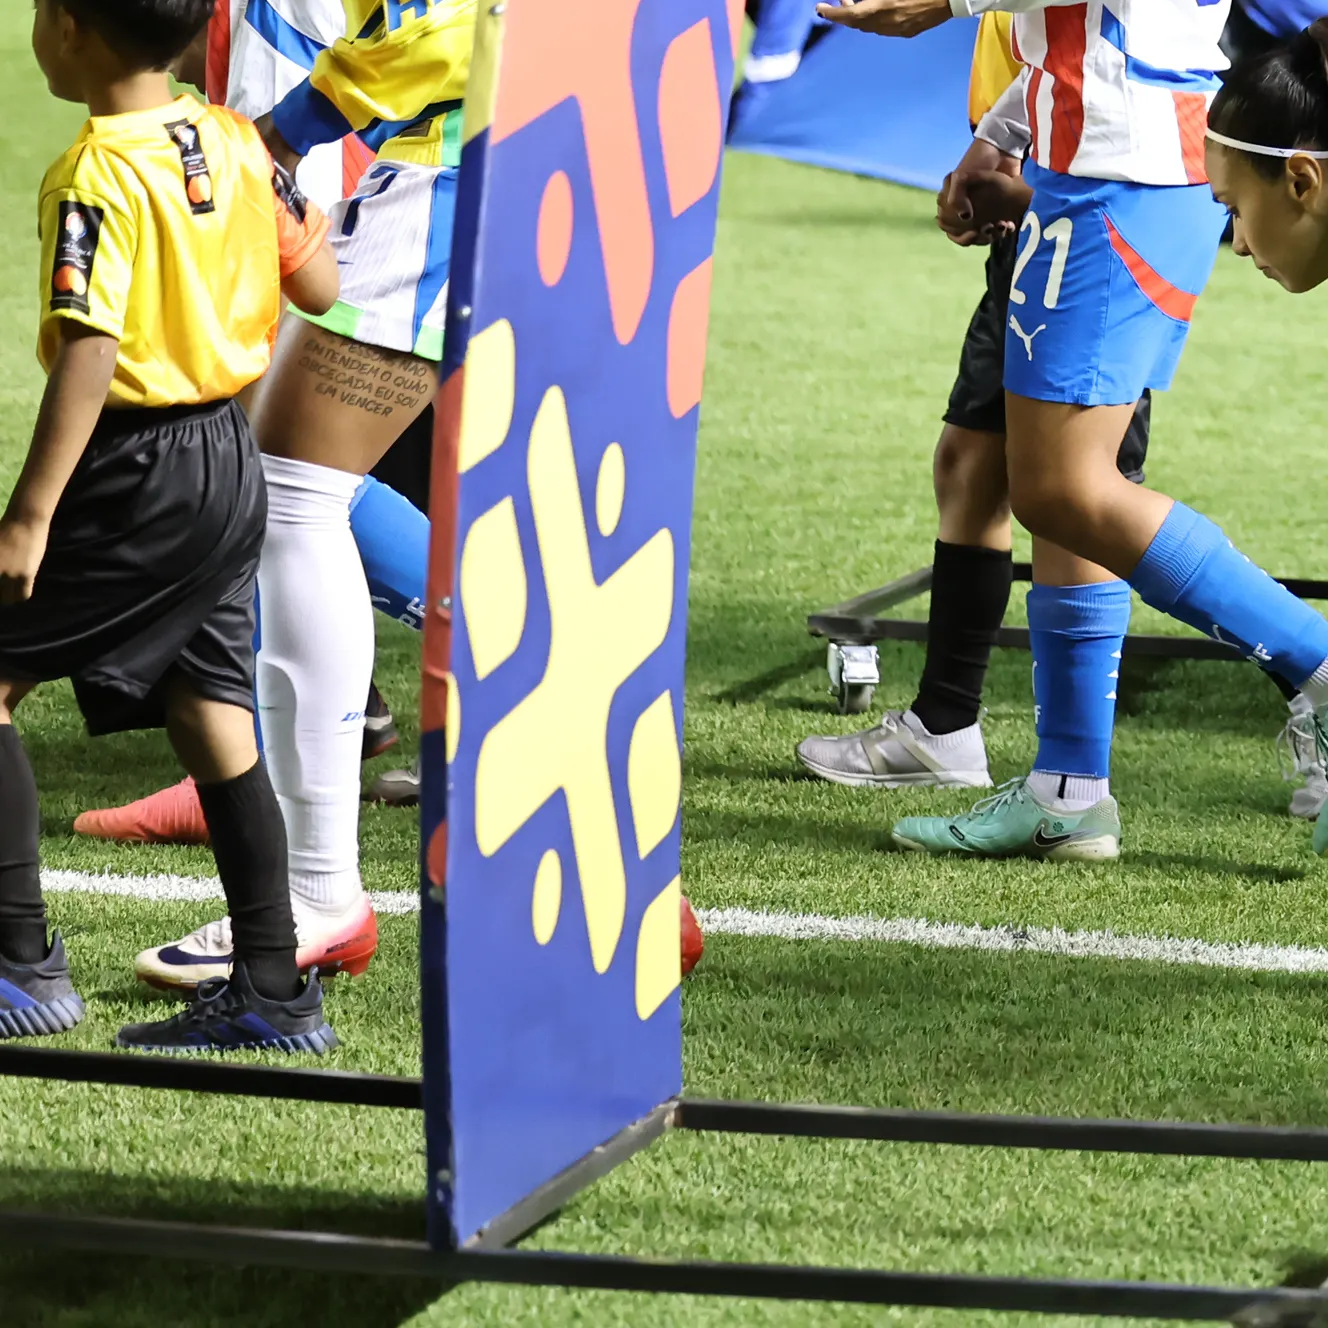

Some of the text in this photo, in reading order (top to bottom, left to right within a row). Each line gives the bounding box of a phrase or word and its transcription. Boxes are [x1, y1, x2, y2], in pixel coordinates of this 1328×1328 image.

[1009, 211, 1073, 309] 21
[298, 356, 420, 409] OBCECADA EU SOU
[304, 339, 379, 378] ENTENDEM
[380, 371, 393, 382] O
[315, 382, 394, 418] EM VENCER
